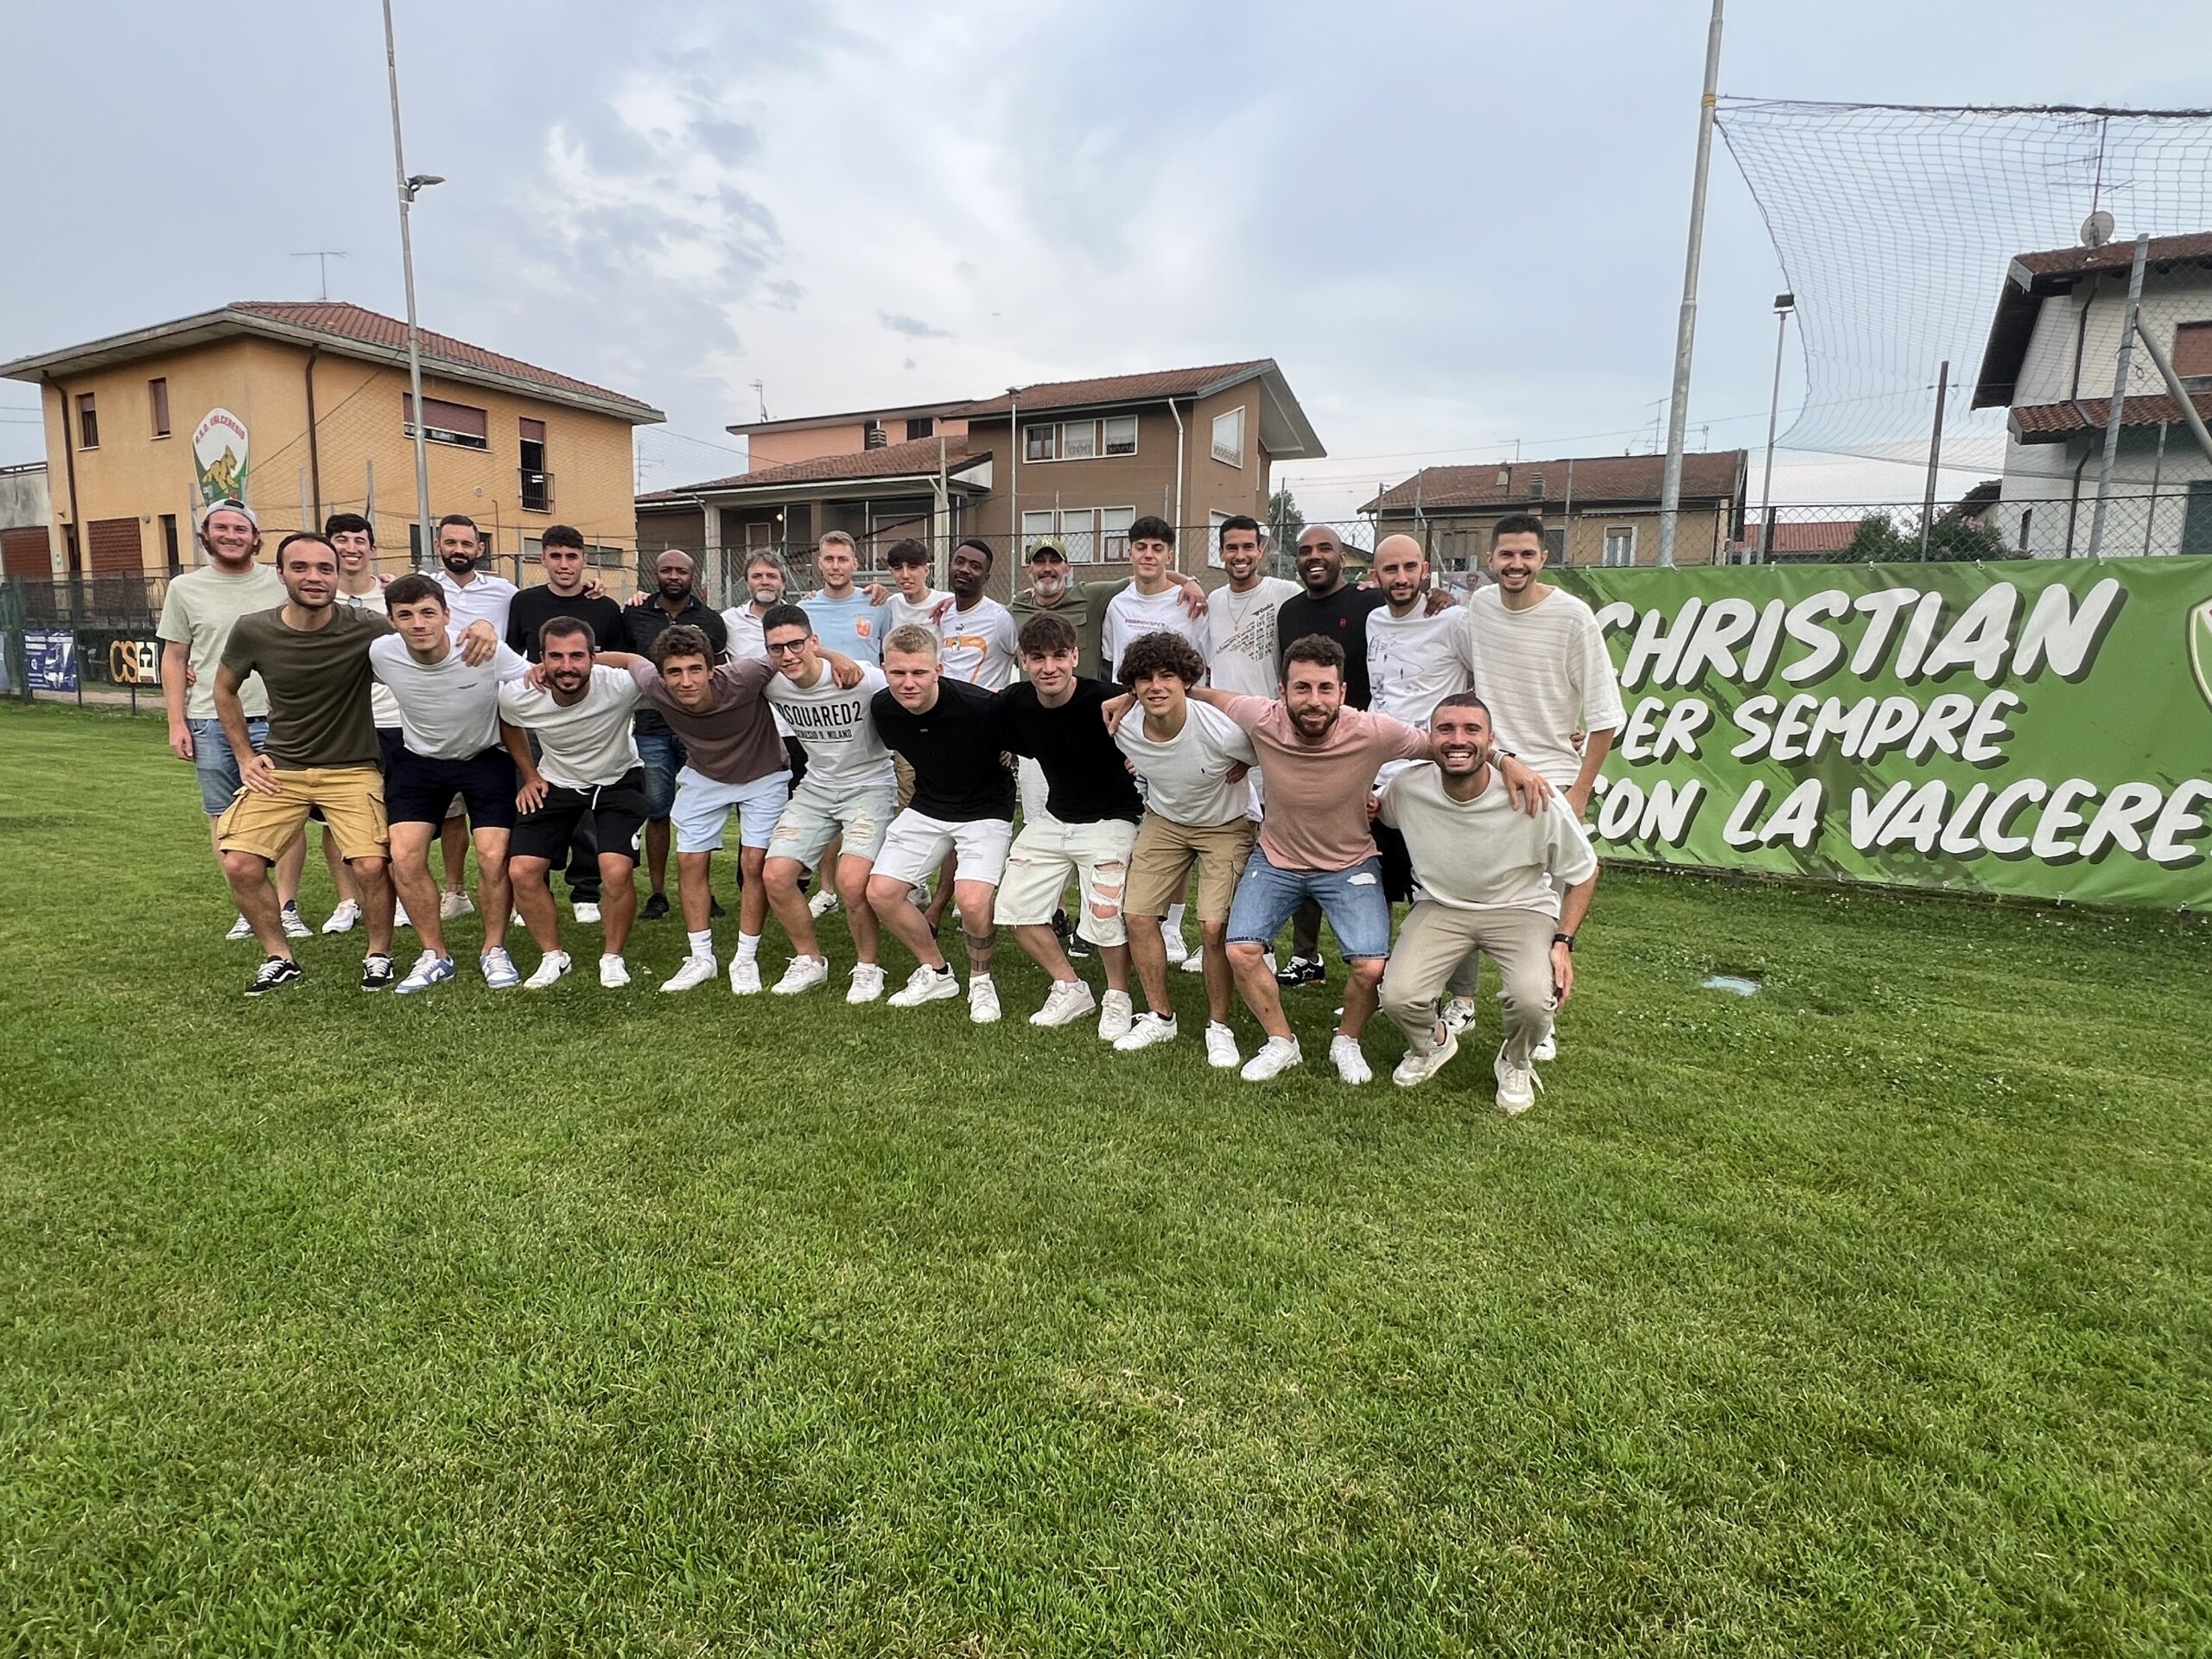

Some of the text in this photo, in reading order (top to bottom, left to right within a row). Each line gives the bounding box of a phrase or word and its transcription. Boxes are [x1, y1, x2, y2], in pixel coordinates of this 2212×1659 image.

[1594, 578, 2120, 689] CHRISTIAN
[1613, 690, 2019, 762] ER SEMPRE
[1723, 778, 1823, 849] LA
[1851, 777, 2212, 862] VALCERE
